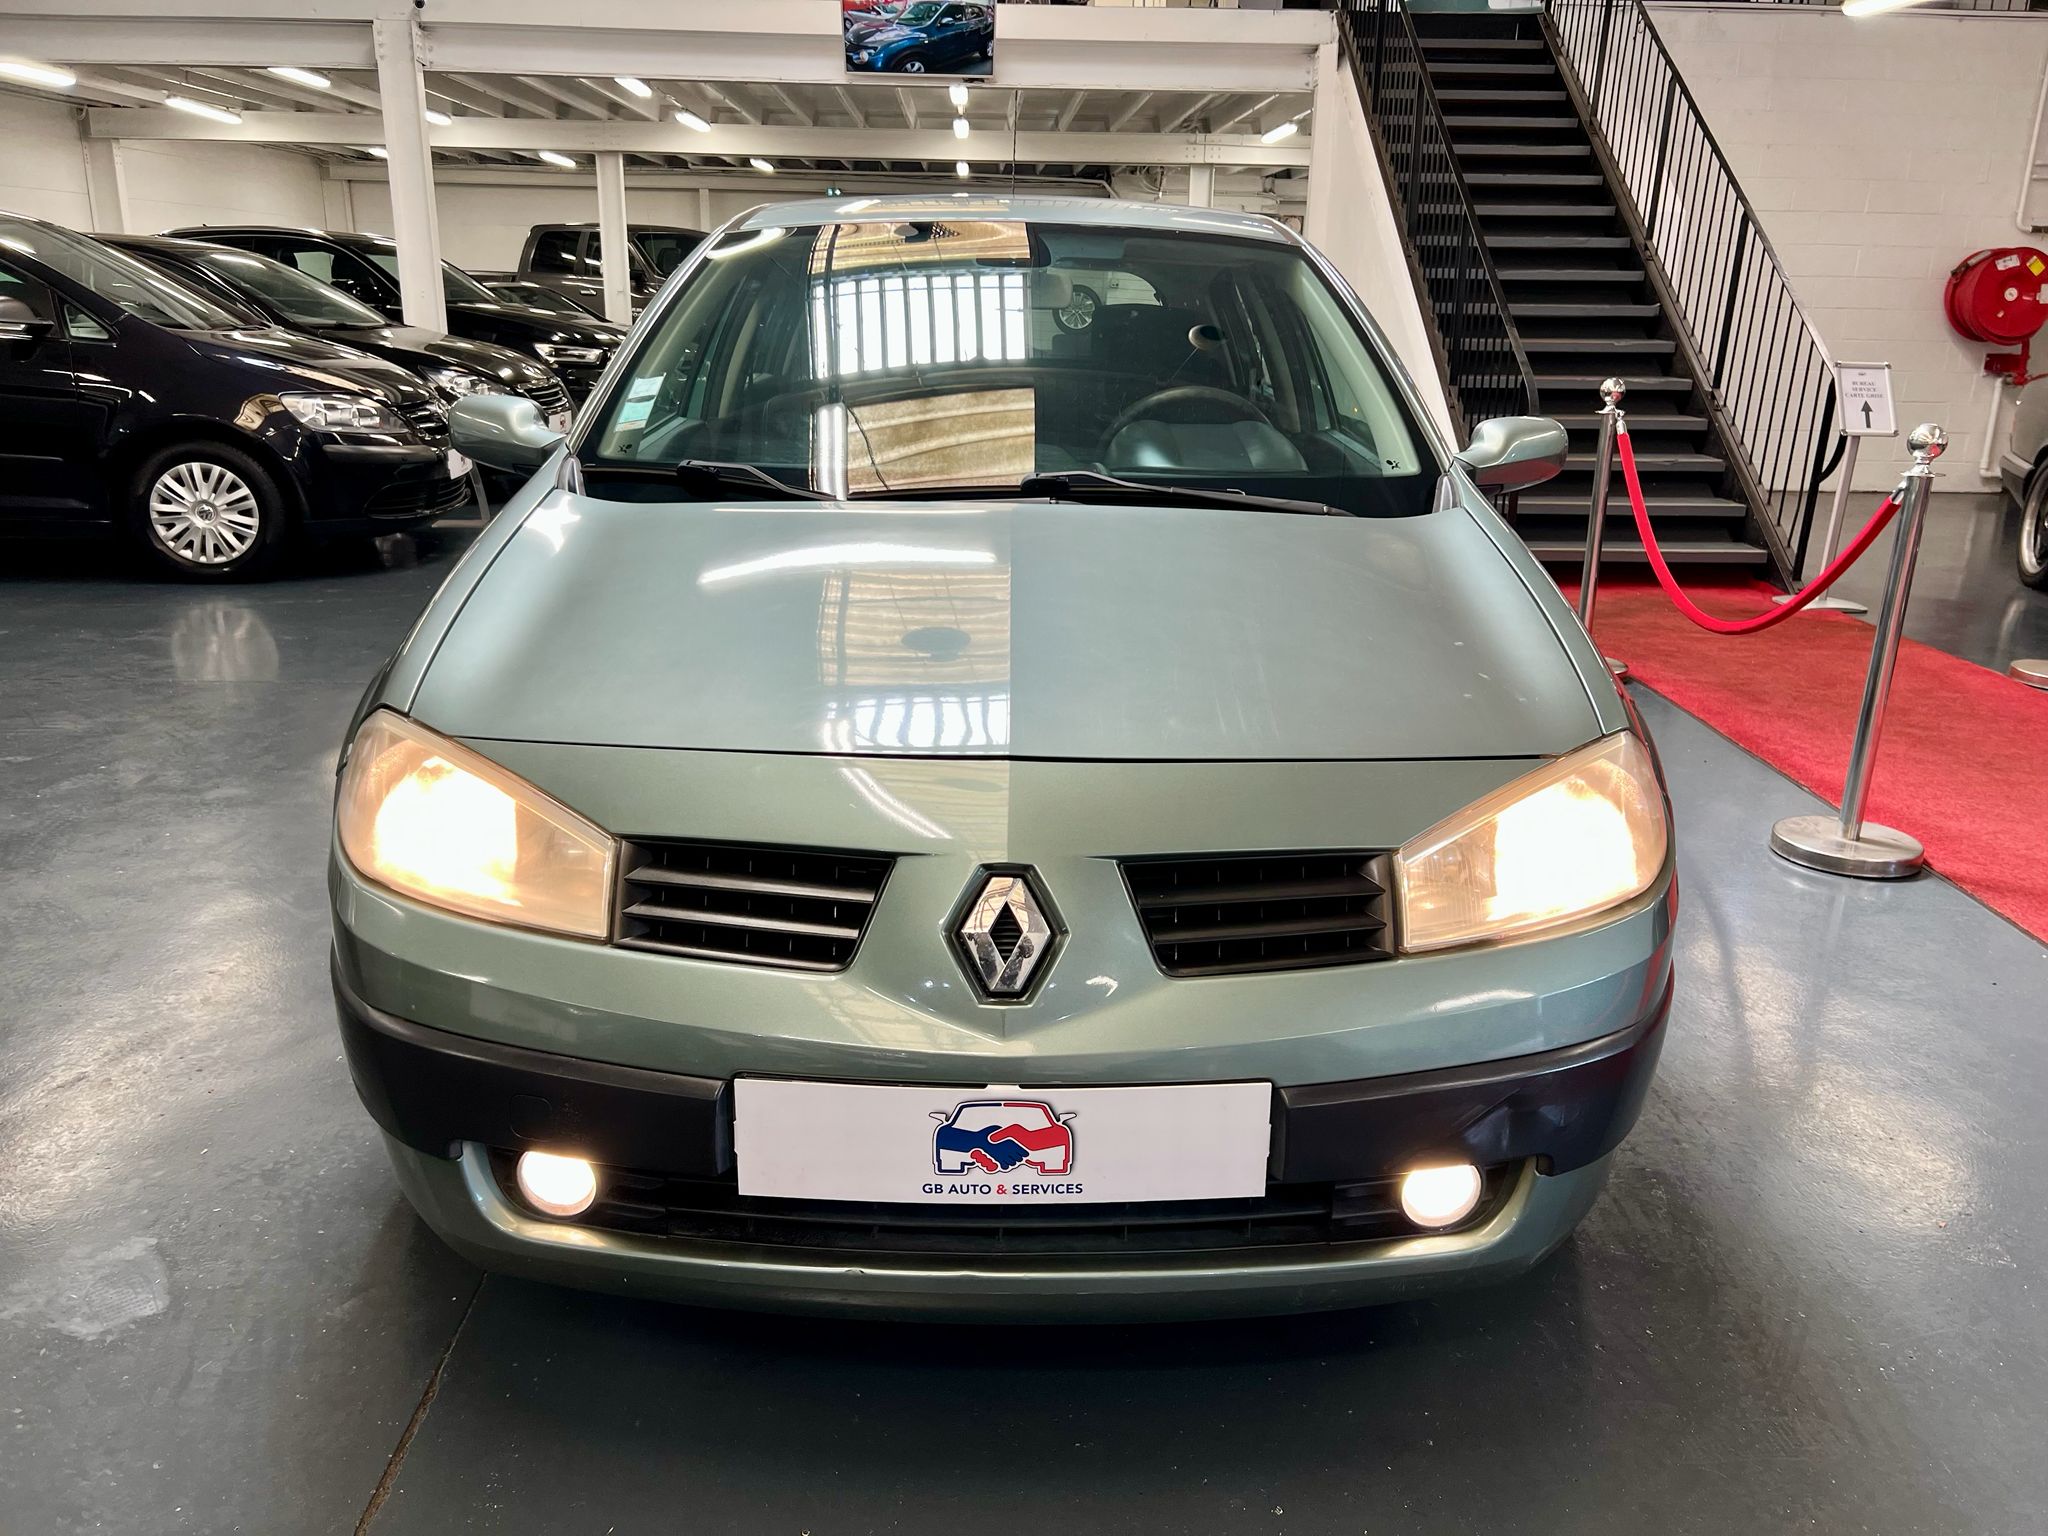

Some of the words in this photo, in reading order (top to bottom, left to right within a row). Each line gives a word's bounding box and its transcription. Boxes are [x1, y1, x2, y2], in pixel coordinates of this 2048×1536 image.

[922, 1183, 944, 1194] GB
[948, 1184, 992, 1195] AUTO
[996, 1184, 1007, 1195] &
[1012, 1183, 1083, 1195] SERVICES
